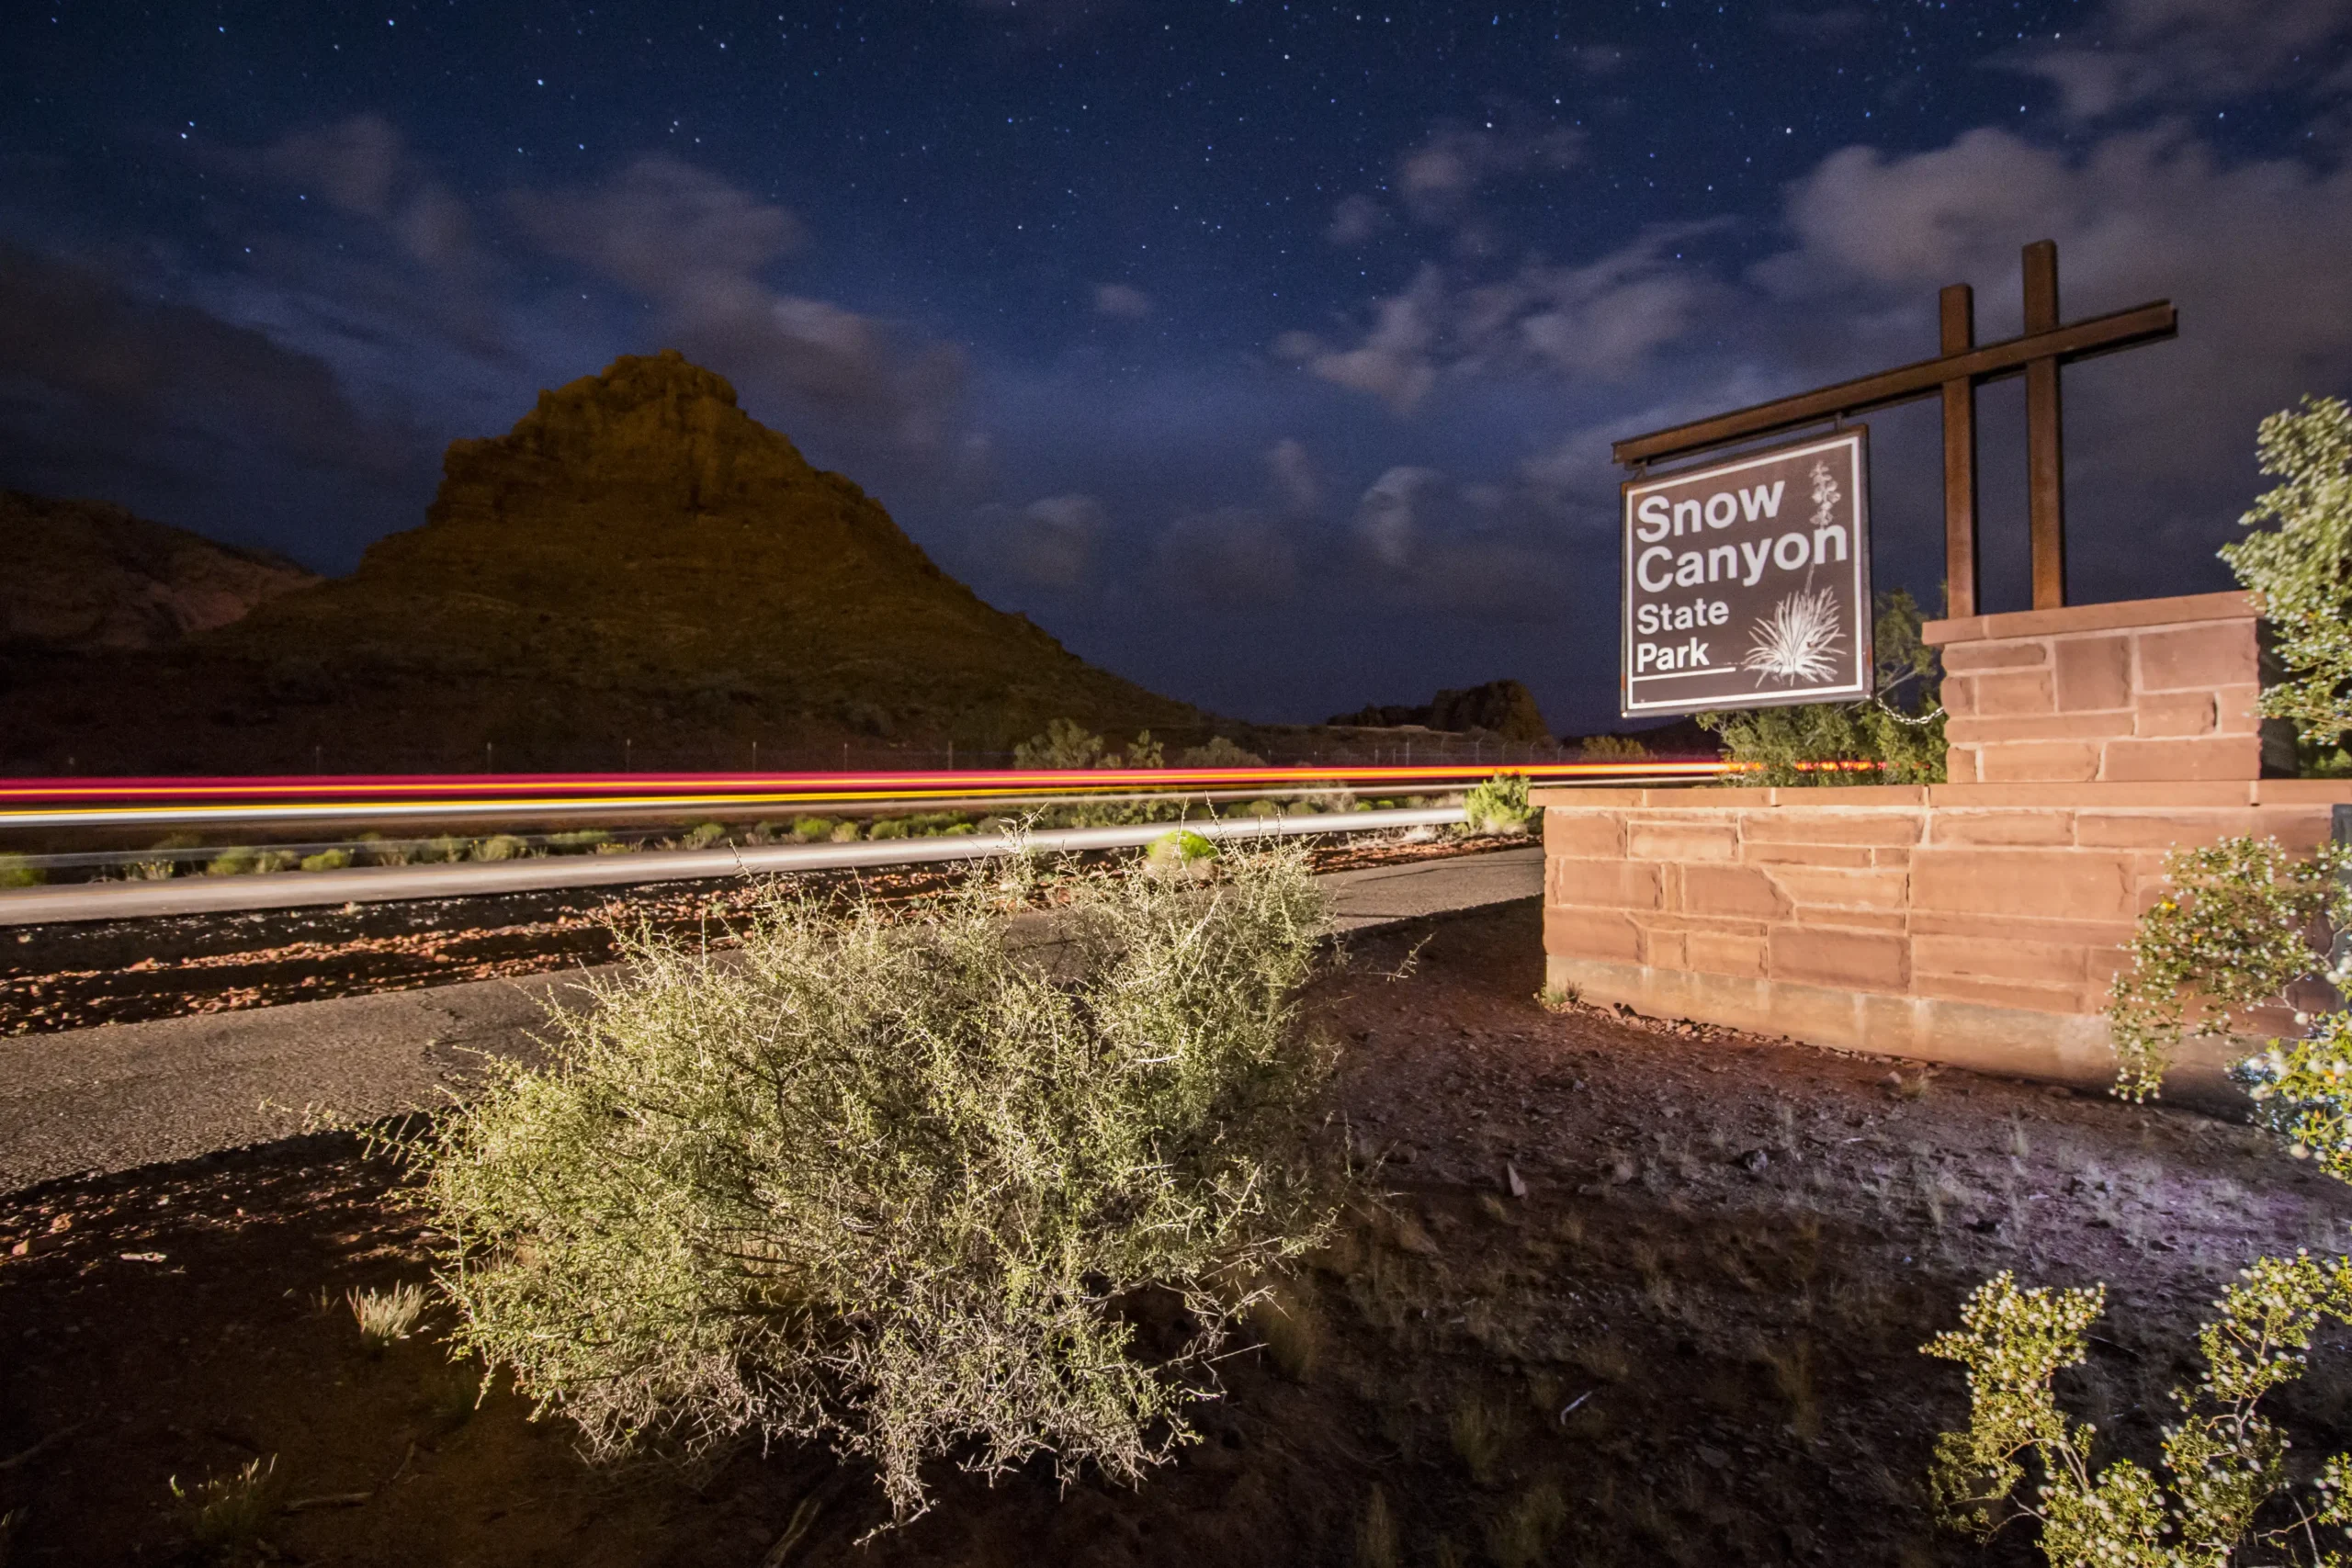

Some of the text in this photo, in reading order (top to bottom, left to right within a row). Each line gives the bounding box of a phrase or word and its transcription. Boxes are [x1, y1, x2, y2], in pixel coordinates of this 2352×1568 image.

[1636, 480, 1786, 543] Snow
[1636, 525, 1848, 593] Canyon
[1636, 598, 1729, 635] State
[1636, 637, 1711, 673] Park
